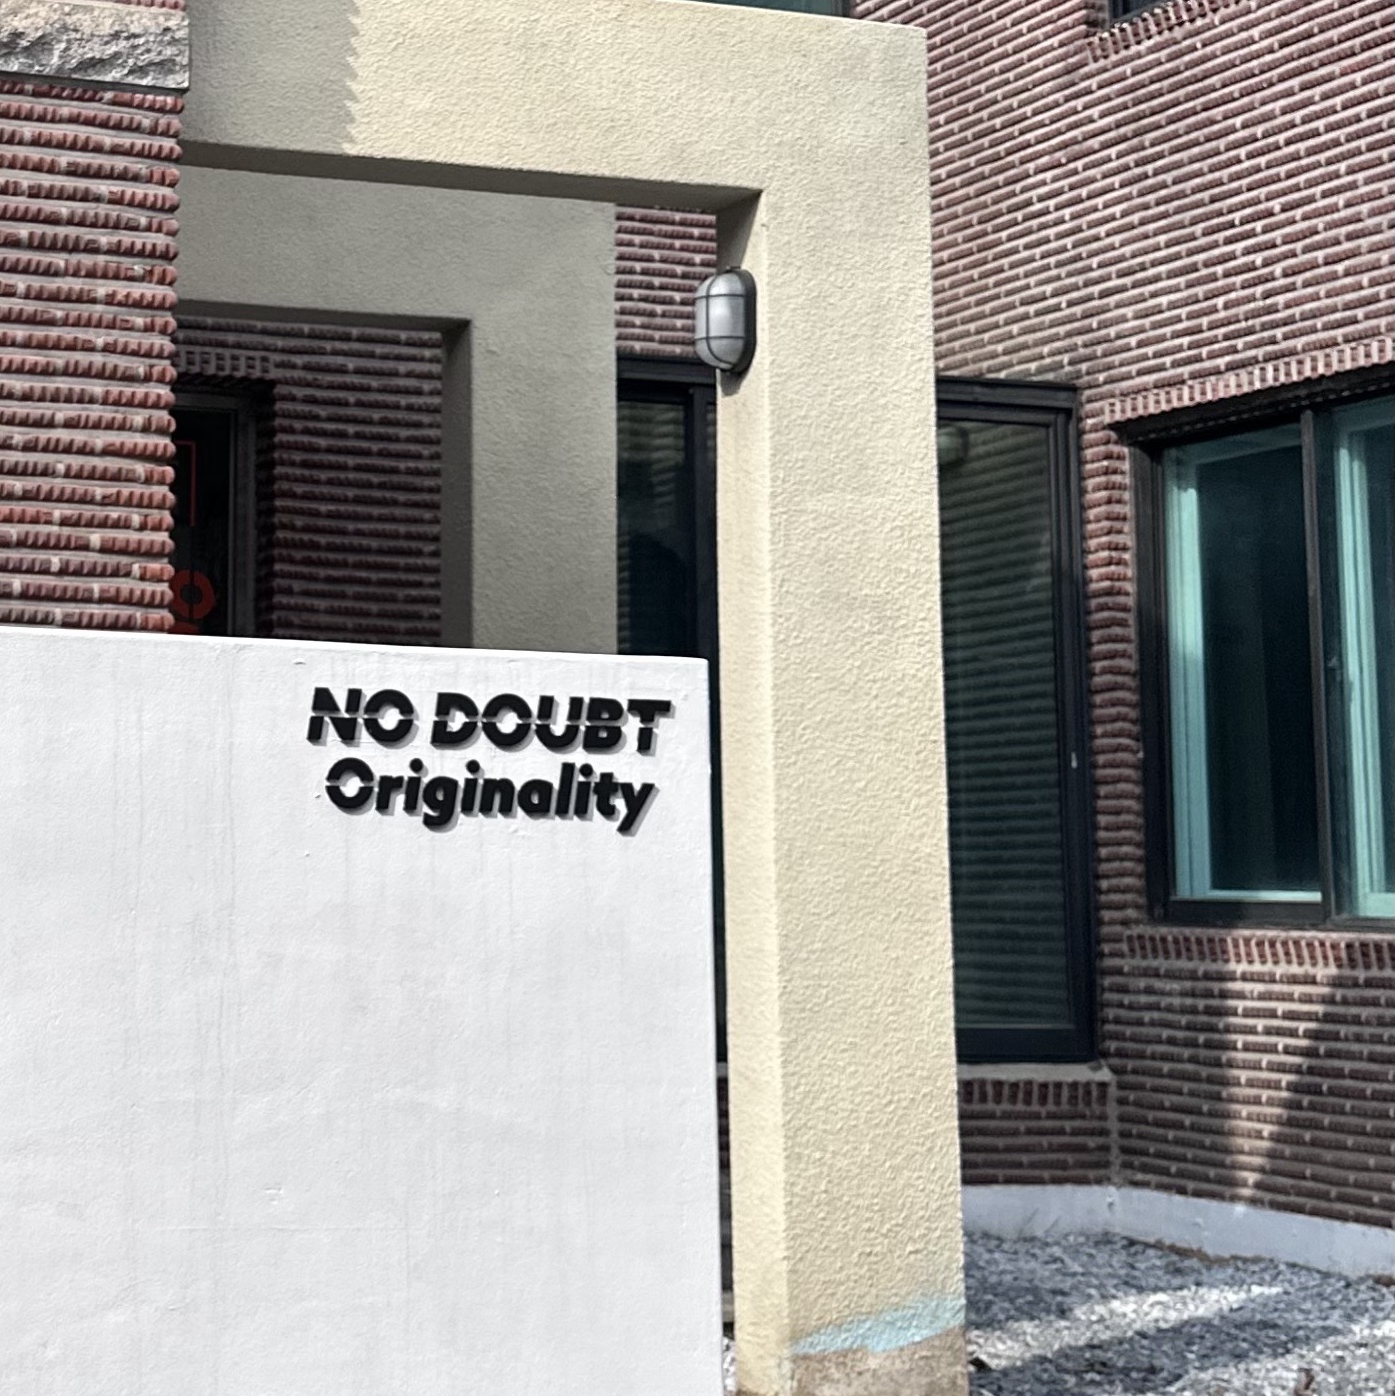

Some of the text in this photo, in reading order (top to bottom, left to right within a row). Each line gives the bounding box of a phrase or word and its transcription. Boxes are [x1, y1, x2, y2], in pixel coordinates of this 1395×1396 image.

[307, 687, 673, 754] NO DOUBT
[325, 757, 656, 835] Originality
